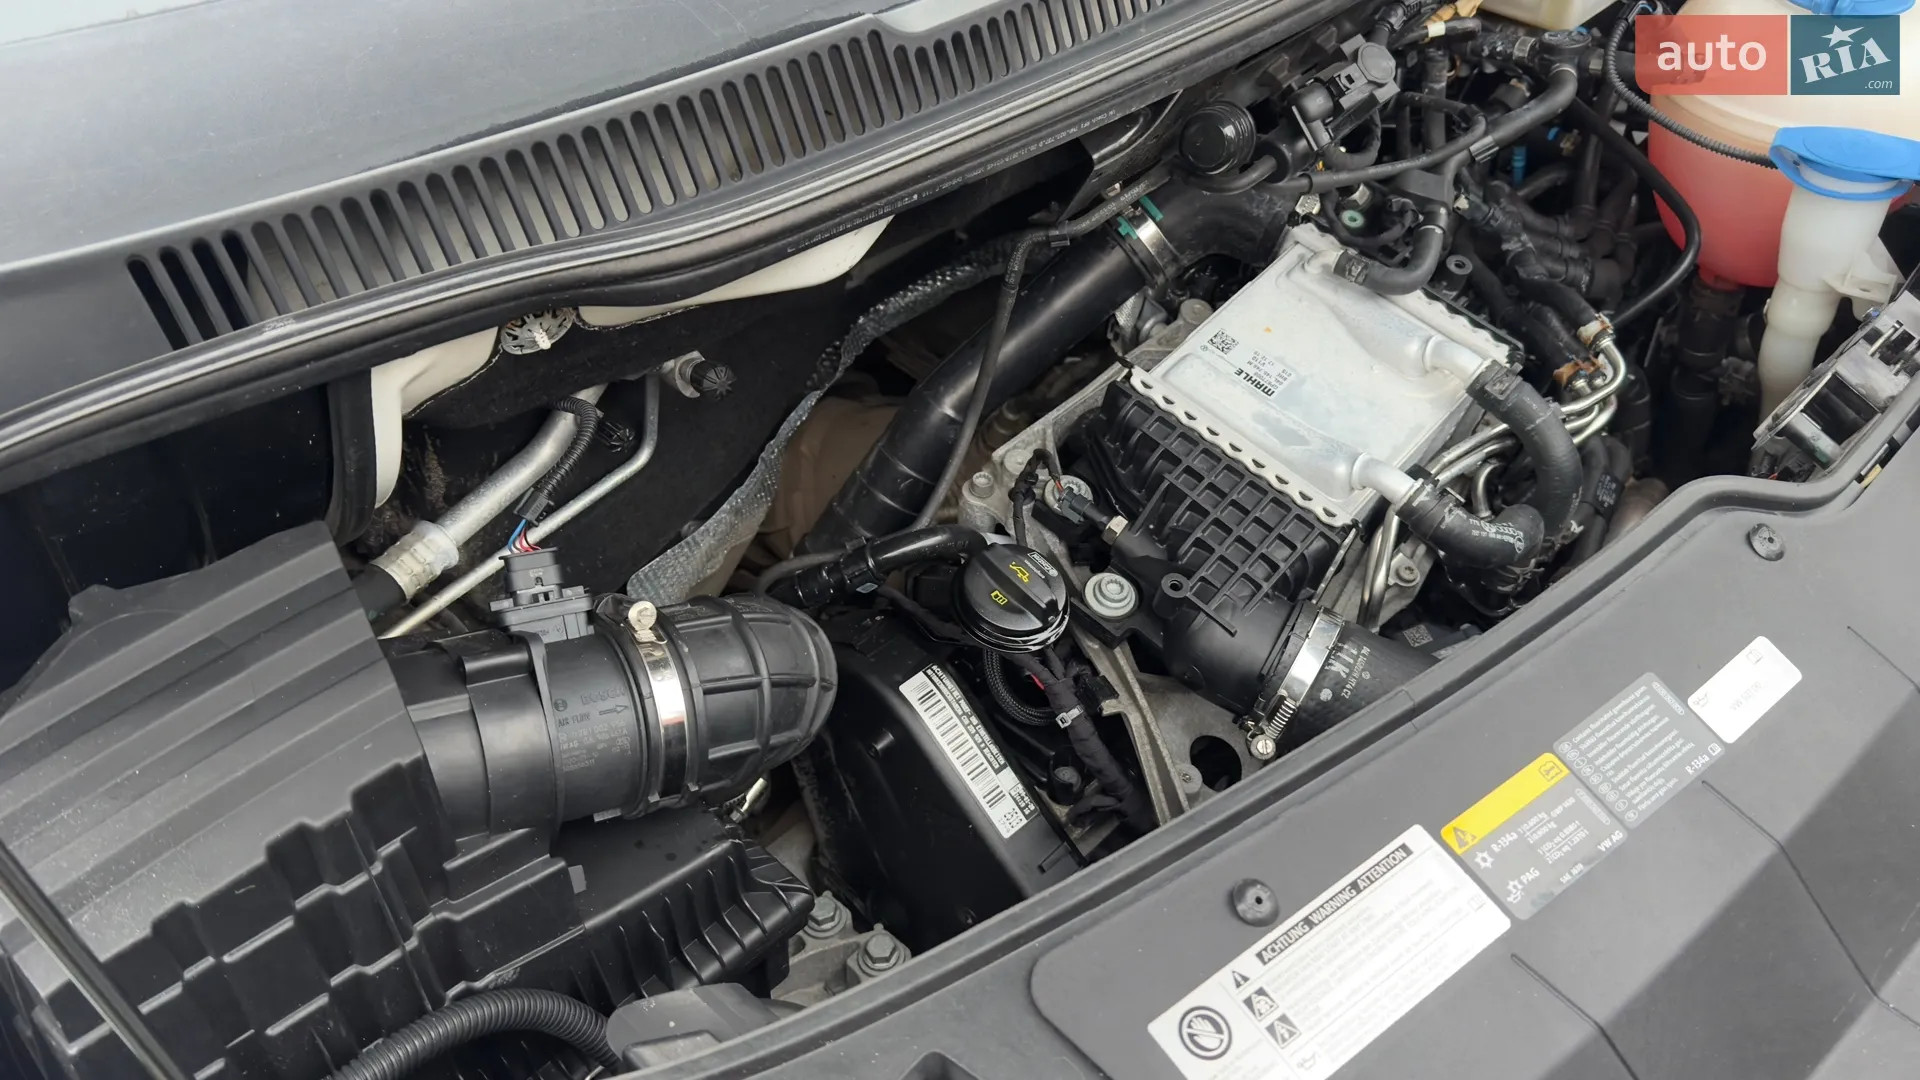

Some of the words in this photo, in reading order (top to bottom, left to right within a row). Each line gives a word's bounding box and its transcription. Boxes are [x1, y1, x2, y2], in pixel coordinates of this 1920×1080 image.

[1234, 366, 1275, 397] MAHLE
[557, 717, 569, 727] AIR
[1684, 752, 1710, 775] R-134a
[1490, 828, 1519, 854] R-134a
[1597, 837, 1613, 852] VW
[1609, 829, 1624, 843] AG
[1519, 865, 1541, 886] PAG
[1259, 920, 1310, 962] ACHTUNG
[1309, 885, 1356, 924] WARNING
[1355, 847, 1407, 889] ATTENTION
